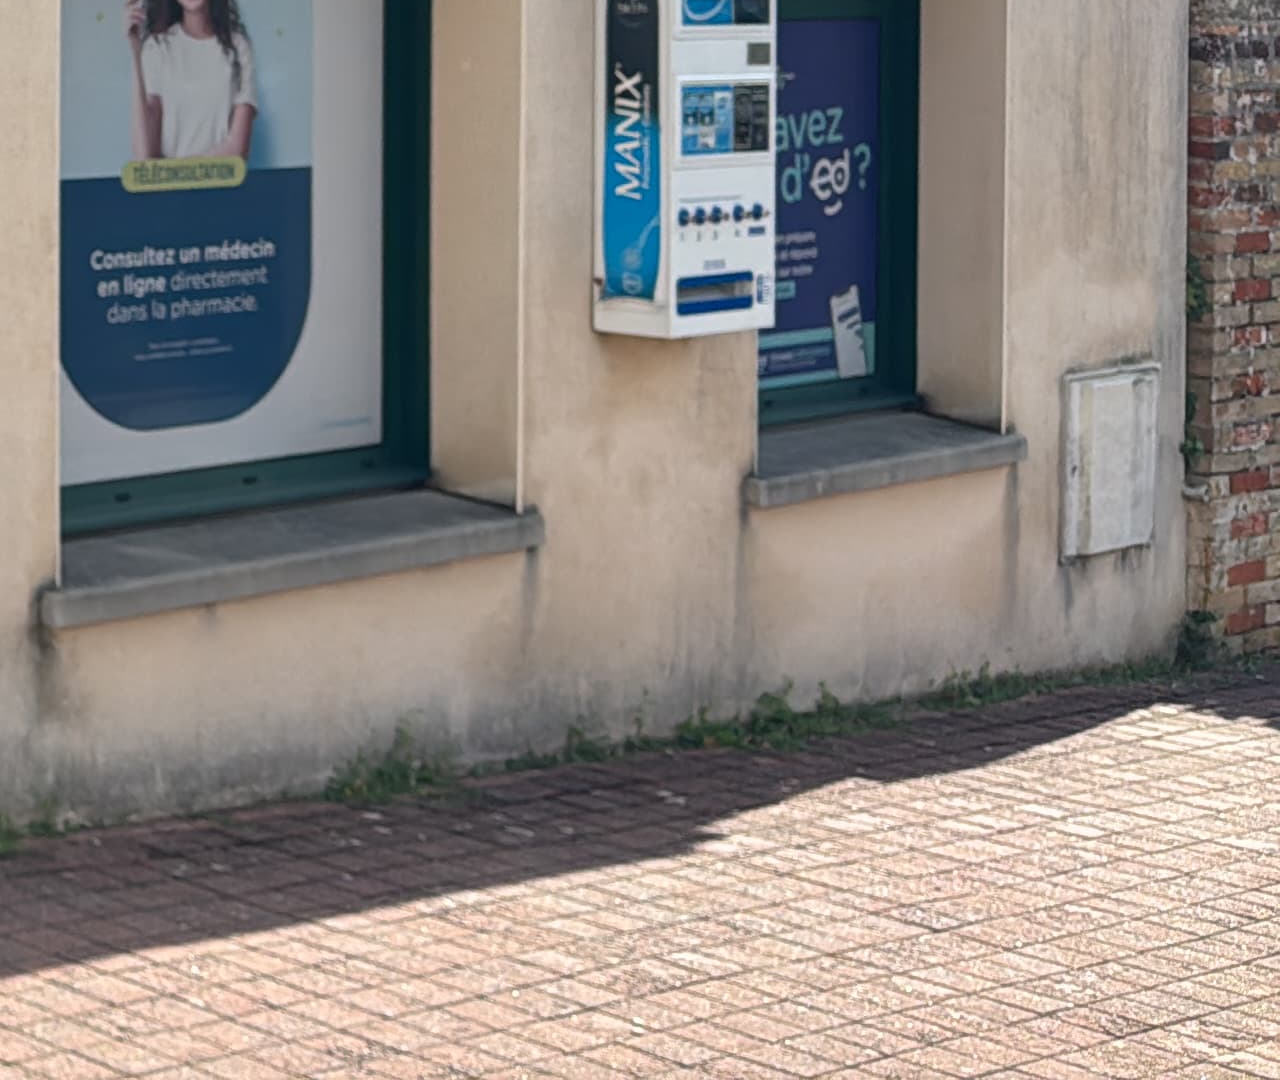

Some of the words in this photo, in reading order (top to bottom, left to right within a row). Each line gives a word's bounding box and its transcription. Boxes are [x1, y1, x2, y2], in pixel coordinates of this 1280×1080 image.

[615, 70, 643, 200] MANIX
[90, 248, 176, 270] Consultez
[179, 246, 201, 264] un
[204, 239, 276, 262] médecin
[96, 279, 119, 298] en
[123, 272, 166, 299] ligne
[170, 265, 268, 291] directement
[106, 301, 148, 325] dans
[151, 298, 166, 321] la
